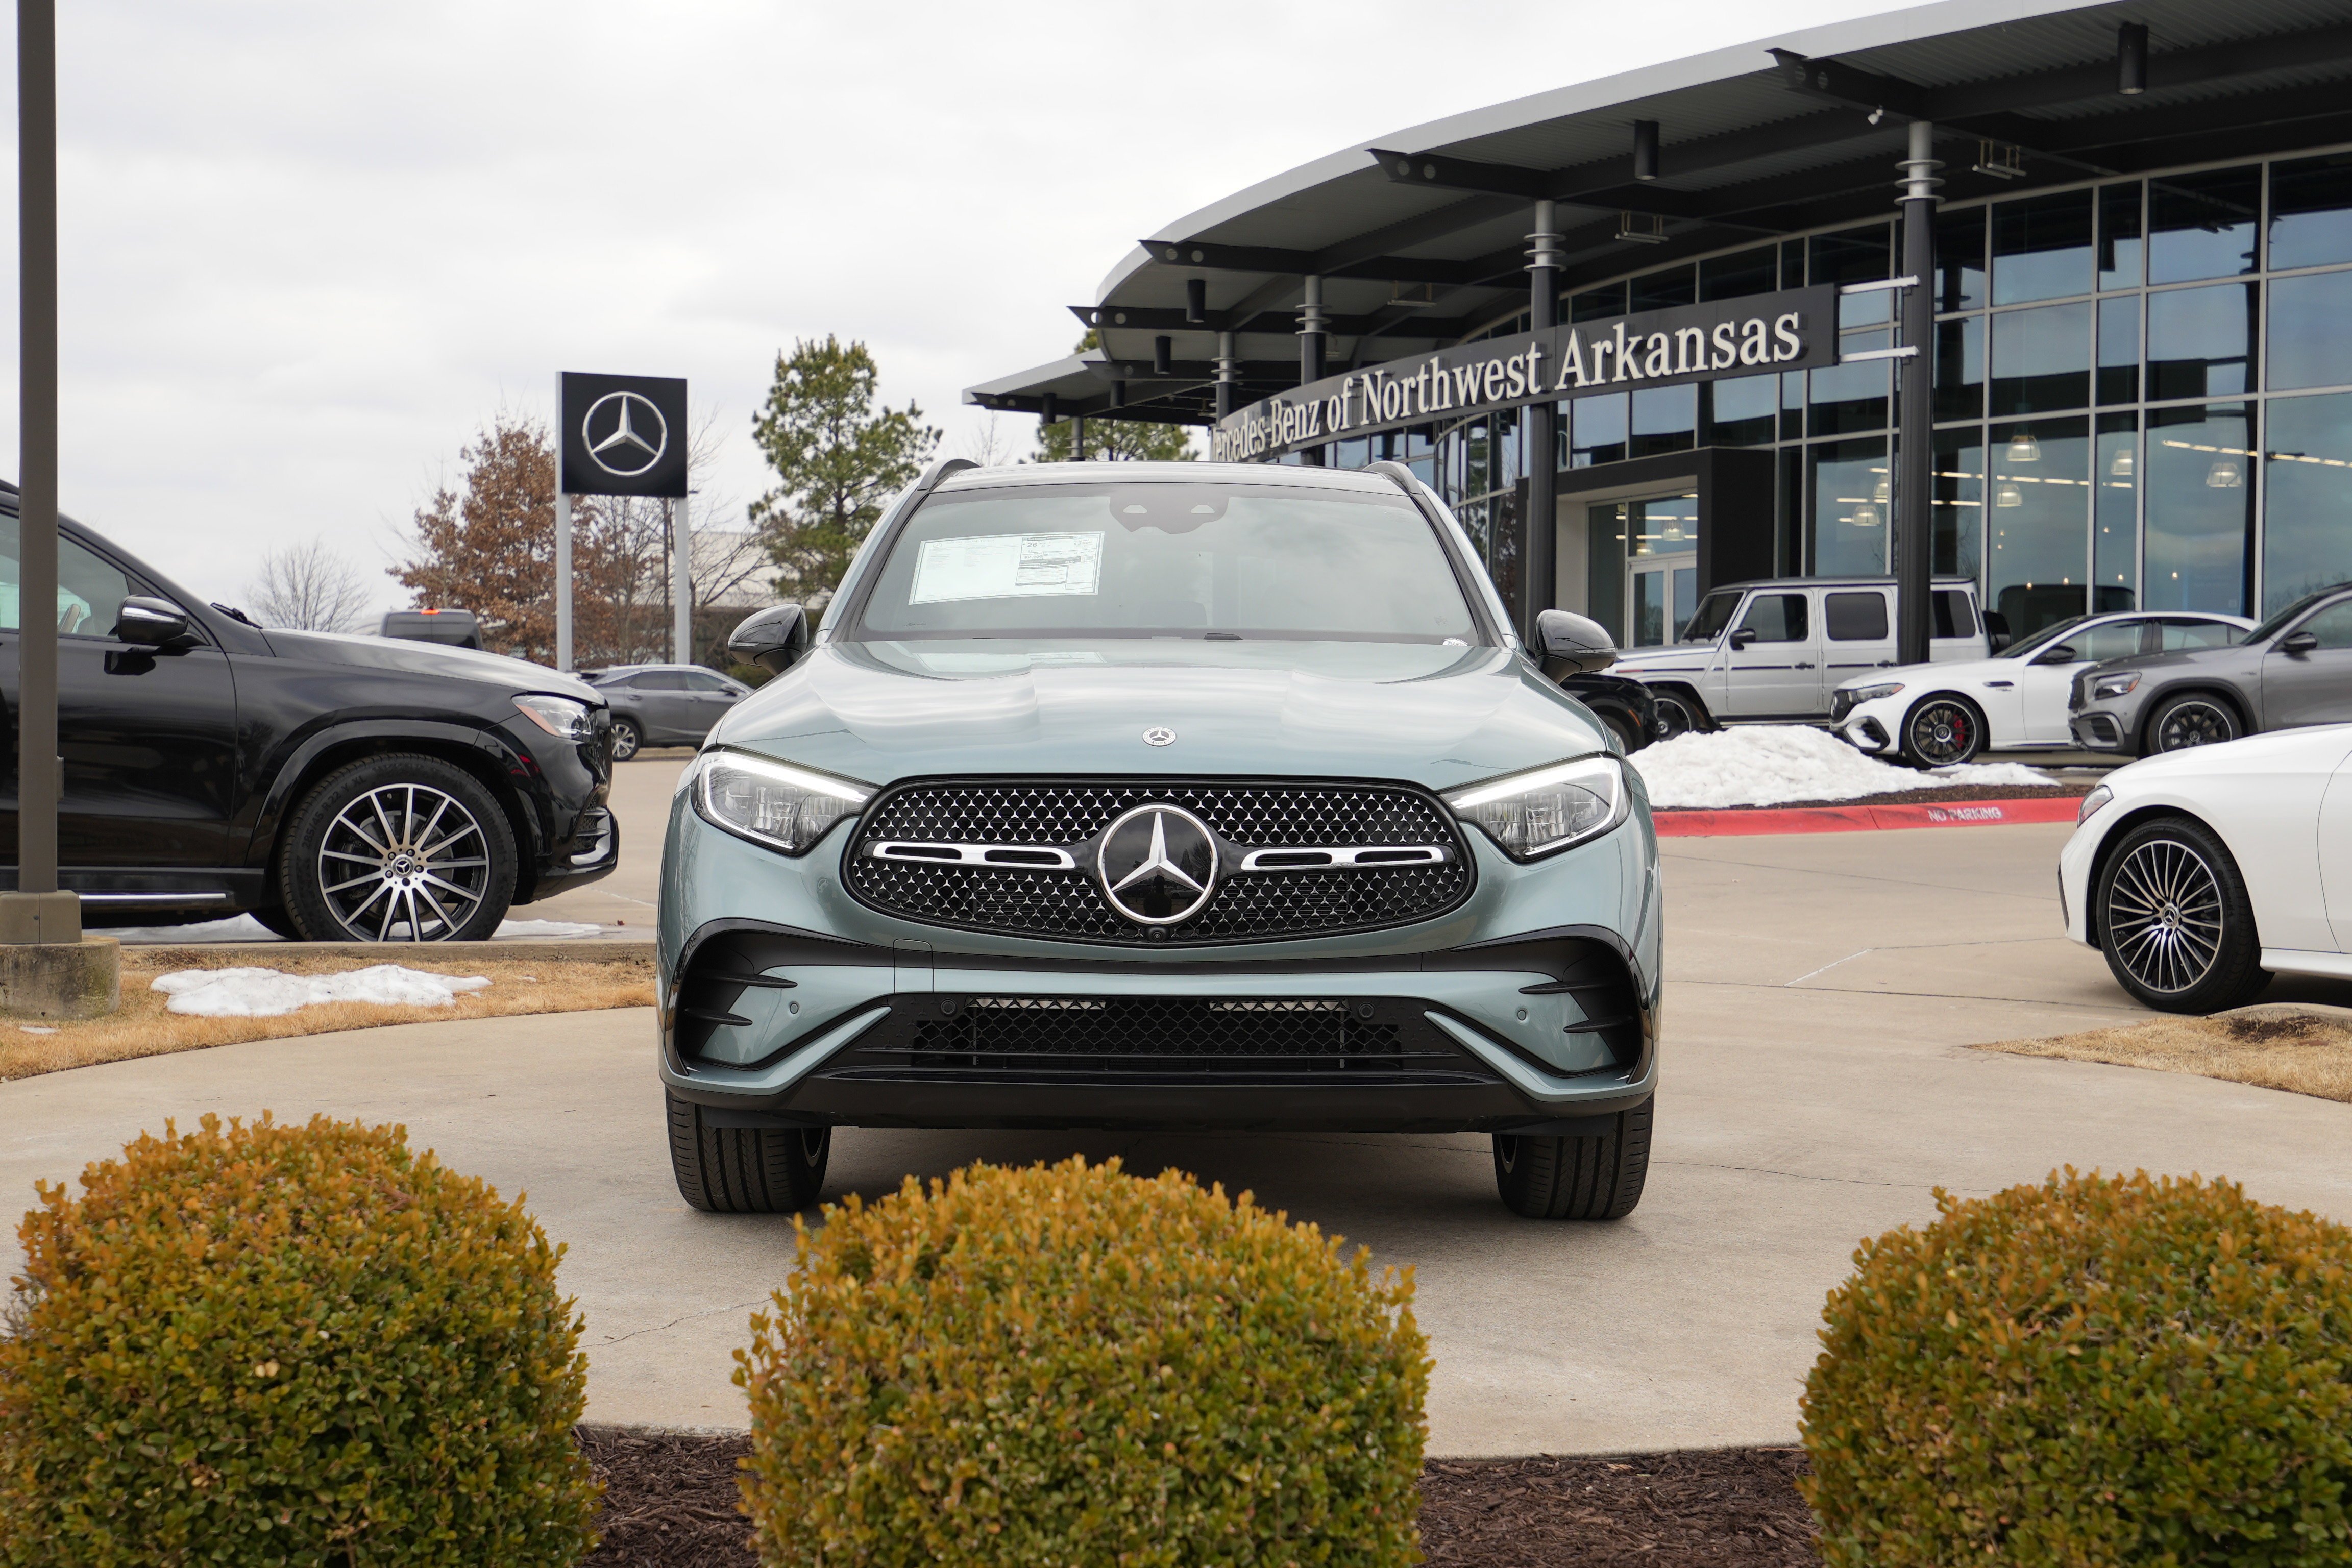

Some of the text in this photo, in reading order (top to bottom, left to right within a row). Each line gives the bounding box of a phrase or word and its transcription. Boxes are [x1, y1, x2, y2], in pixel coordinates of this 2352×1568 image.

[1327, 377, 1354, 433] of
[1361, 341, 1542, 426] Northwest
[1555, 312, 1802, 390] Arkansas
[302, 811, 324, 848] 285/45
[322, 802, 331, 812] R
[328, 791, 341, 804] 22
[352, 775, 368, 787] XL
[1927, 806, 2002, 822] NO PARKING
